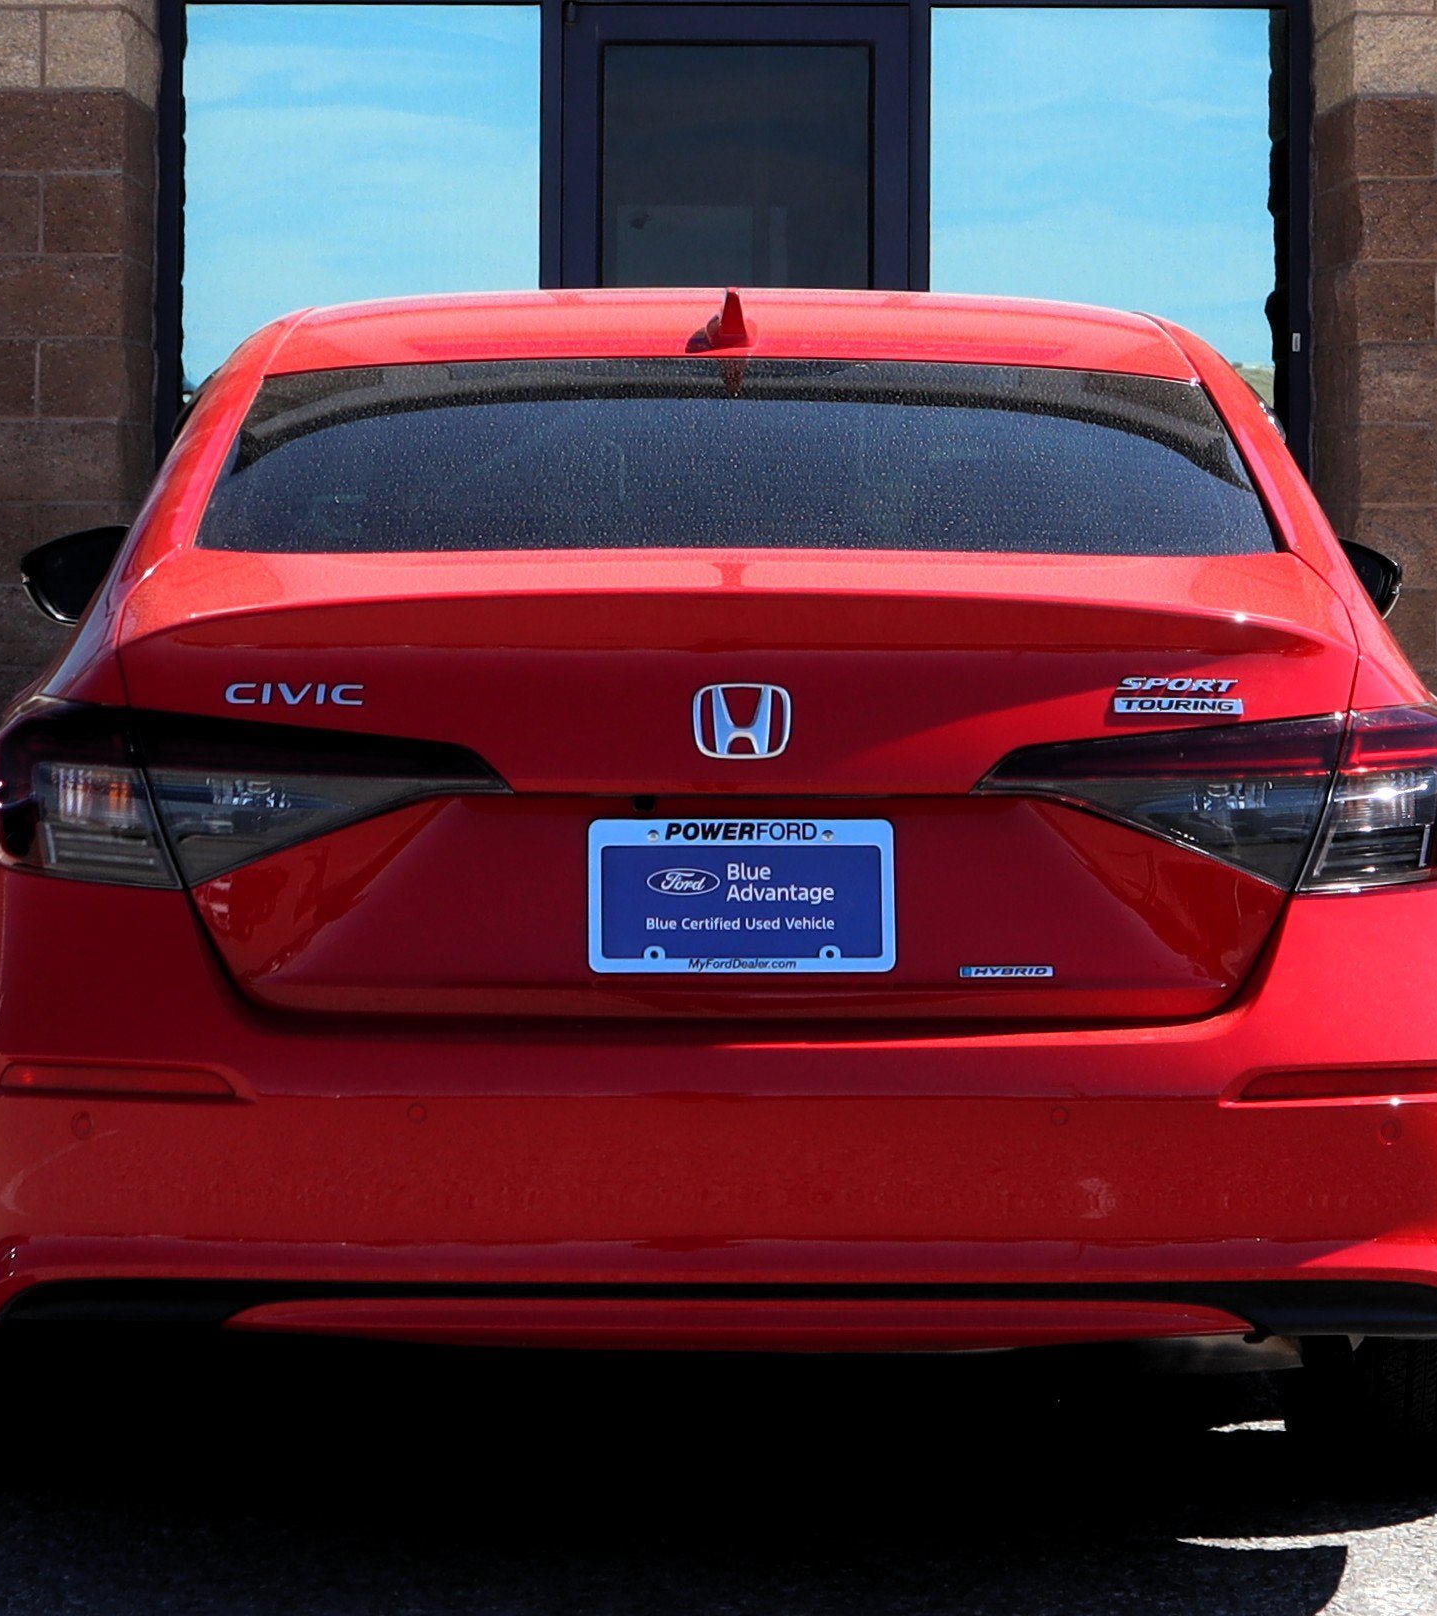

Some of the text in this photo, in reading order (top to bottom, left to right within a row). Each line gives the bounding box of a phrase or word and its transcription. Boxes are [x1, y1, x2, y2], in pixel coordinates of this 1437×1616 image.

[1116, 676, 1239, 692] SPORT
[225, 683, 364, 705] CIVIC
[1121, 699, 1235, 712] TOURING
[727, 863, 771, 881] Blue
[660, 871, 706, 892] Ford
[726, 883, 835, 904] Advantage
[646, 916, 835, 930] Blue Certified Used Vehicle
[688, 958, 797, 971] MyFordDealer.com
[974, 967, 1048, 976] HYBRID
